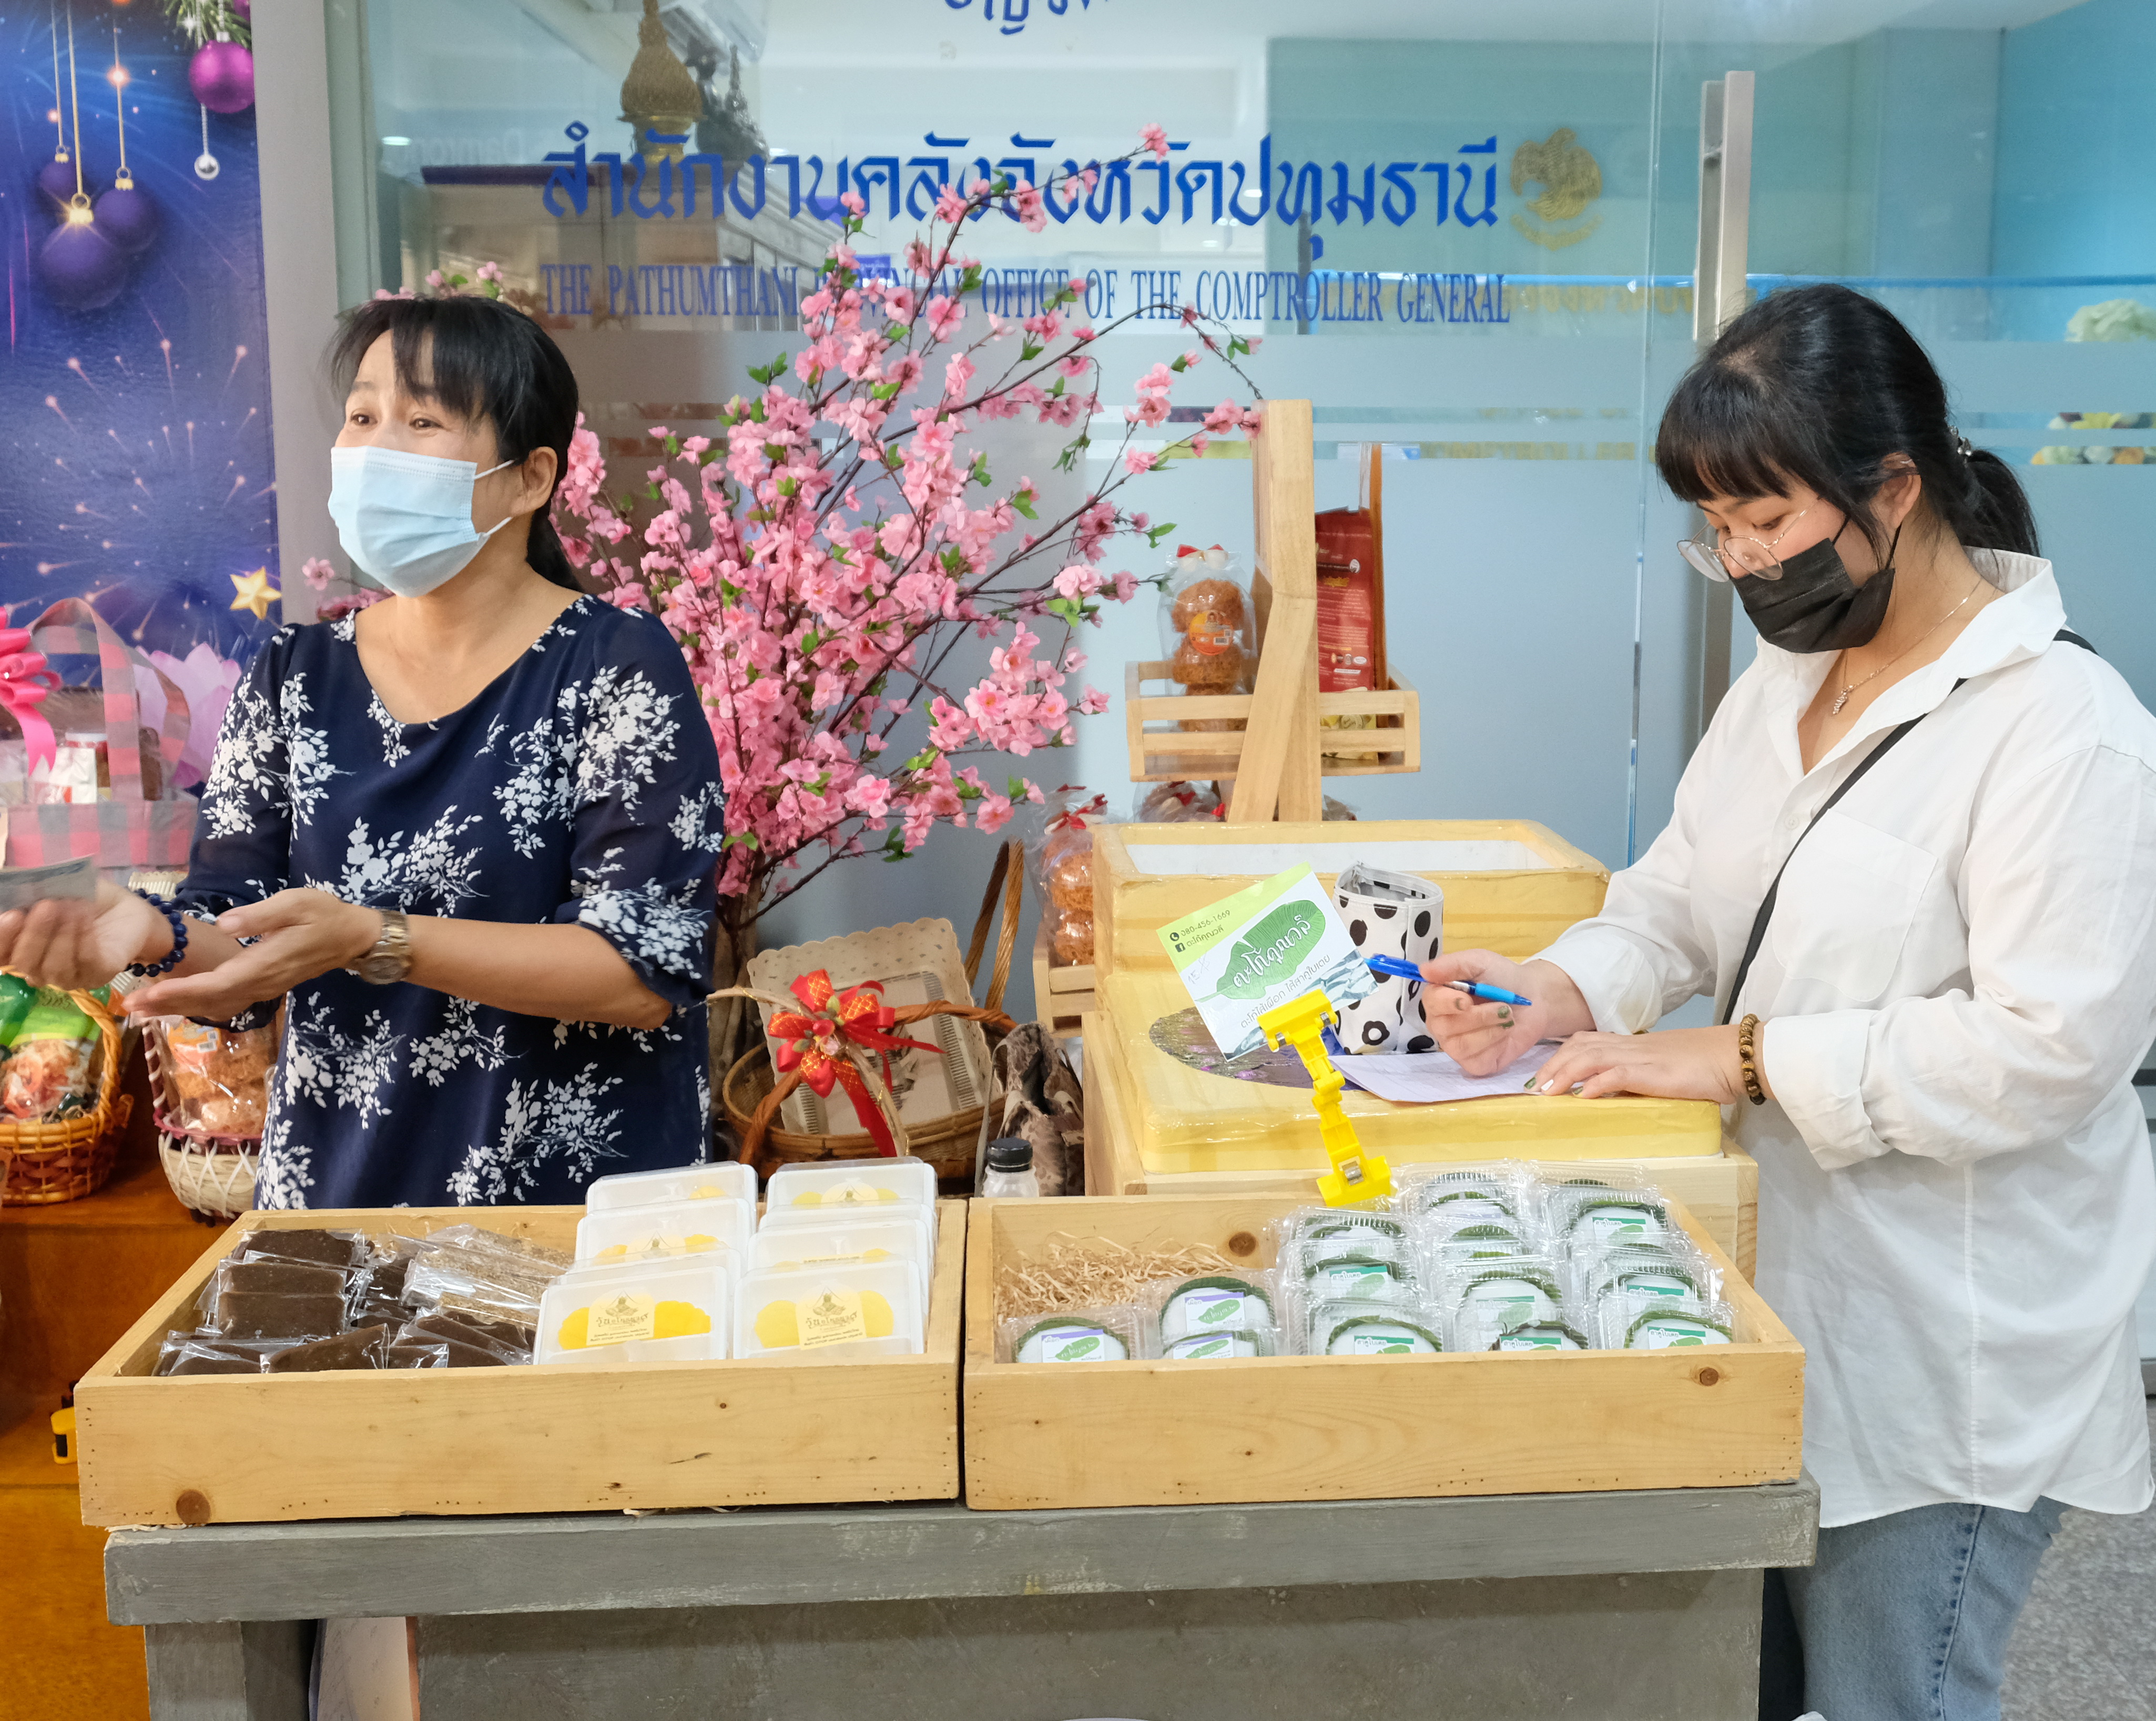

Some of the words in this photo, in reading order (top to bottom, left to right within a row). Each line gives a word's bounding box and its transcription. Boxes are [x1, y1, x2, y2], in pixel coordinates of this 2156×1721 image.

[540, 264, 593, 316] THE
[608, 265, 799, 317] PATHUMTHANI
[981, 267, 1070, 319] OFFICE
[1085, 268, 1118, 319] OF
[1131, 270, 1181, 319] THE
[1196, 270, 1384, 321] COMPTROLLER
[1397, 273, 1510, 323] GENERAL
[1181, 909, 1230, 937] 080-456-1669
